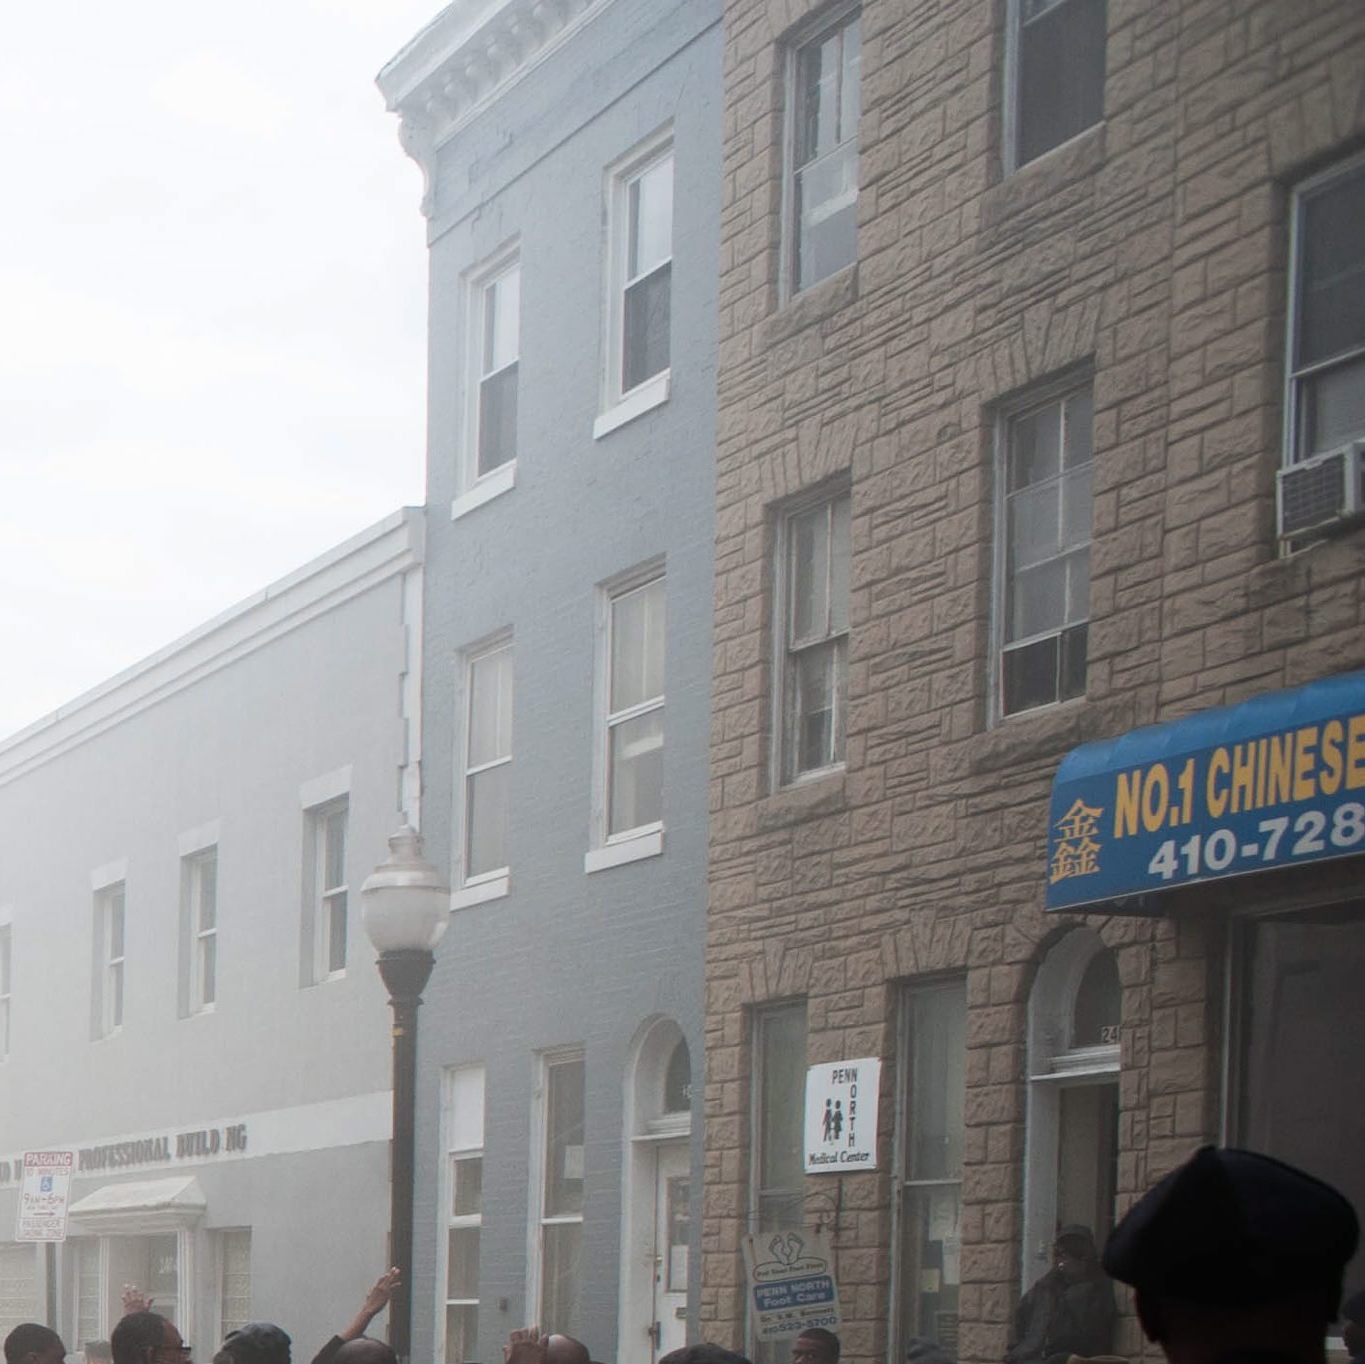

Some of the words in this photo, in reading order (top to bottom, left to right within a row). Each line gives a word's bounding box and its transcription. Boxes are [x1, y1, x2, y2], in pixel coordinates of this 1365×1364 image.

[1114, 757, 1195, 838] NO.1
[1207, 714, 1365, 818] CHINESE
[1049, 798, 1105, 884] 鑫
[1148, 802, 1365, 880] 410-728
[831, 1067, 858, 1084] PENN
[25, 1152, 71, 1166] PARKING
[78, 1136, 171, 1172] PROFESSIONAL
[809, 1151, 838, 1166] Medical
[840, 1150, 870, 1164] Center
[757, 1286, 787, 1298] PENN
[790, 1280, 830, 1292] NORTH
[763, 1296, 793, 1308] Foot
[796, 1292, 826, 1303] Care
